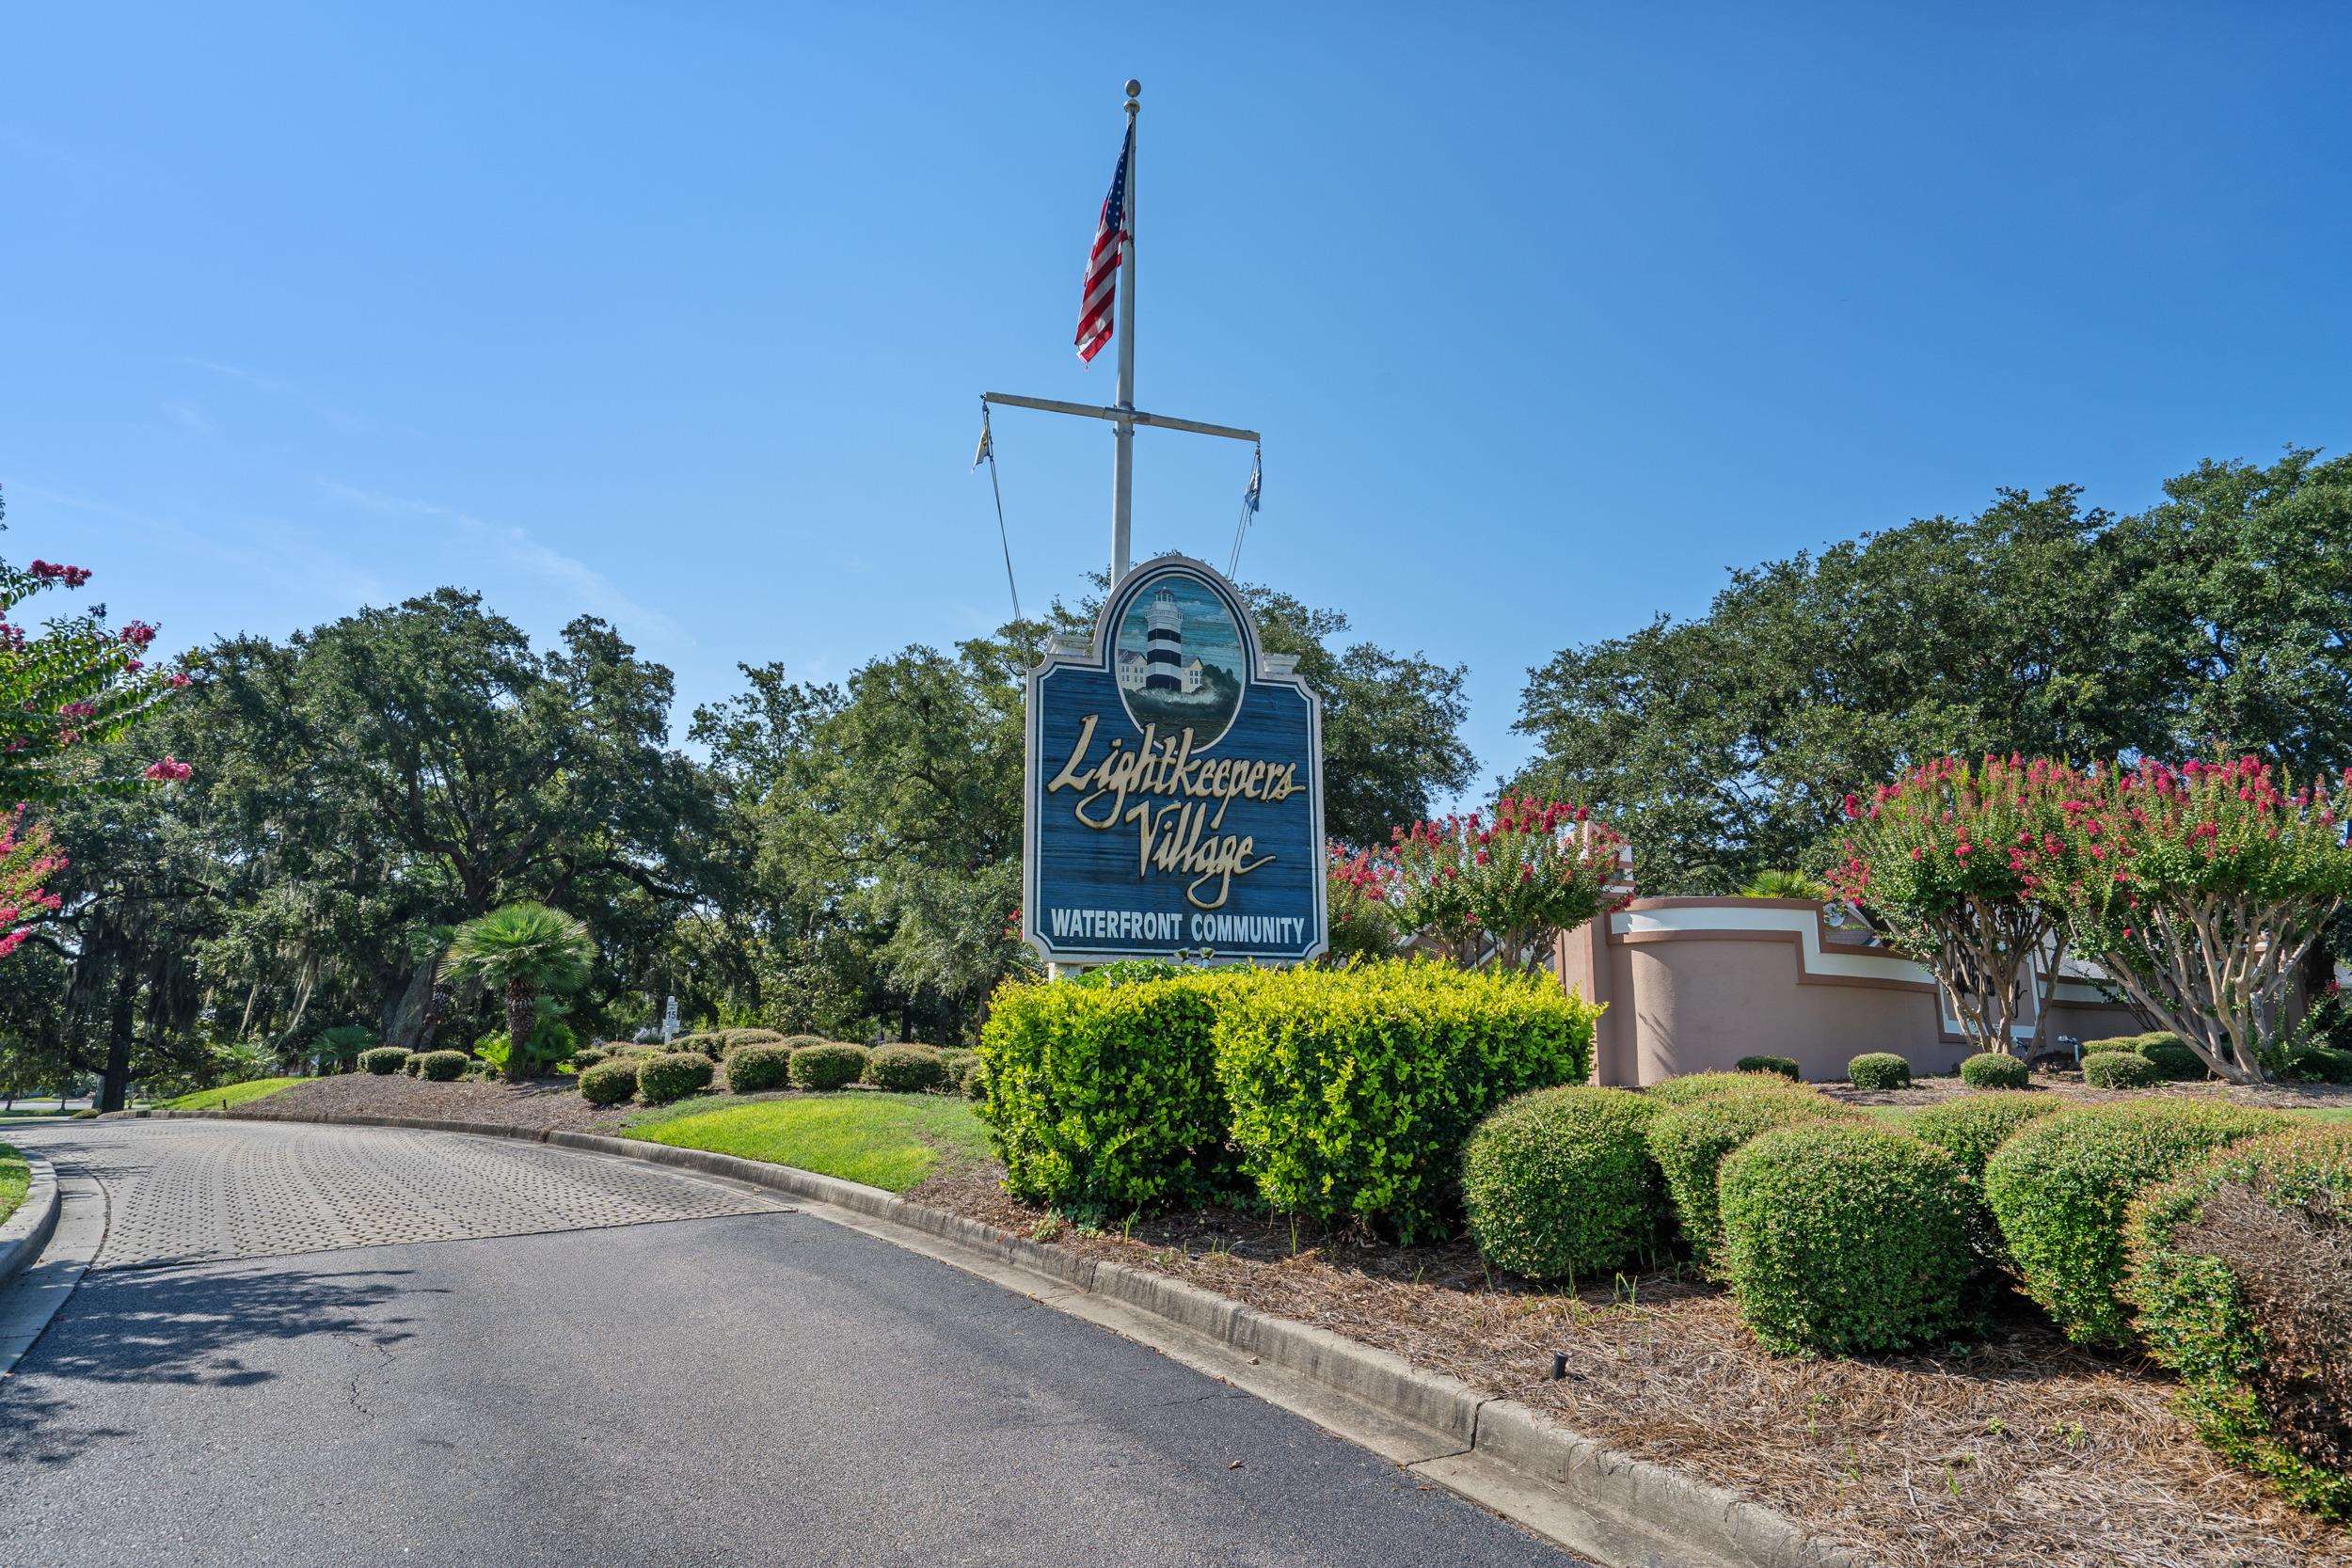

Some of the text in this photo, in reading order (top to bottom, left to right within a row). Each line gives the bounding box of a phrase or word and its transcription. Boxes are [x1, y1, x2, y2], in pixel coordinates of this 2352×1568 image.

[1047, 714, 1306, 830] Lightkeepers
[1125, 800, 1276, 910] Village
[1051, 908, 1305, 943] WATERFRONT COMMUNITY
[668, 1010, 676, 1020] 15
